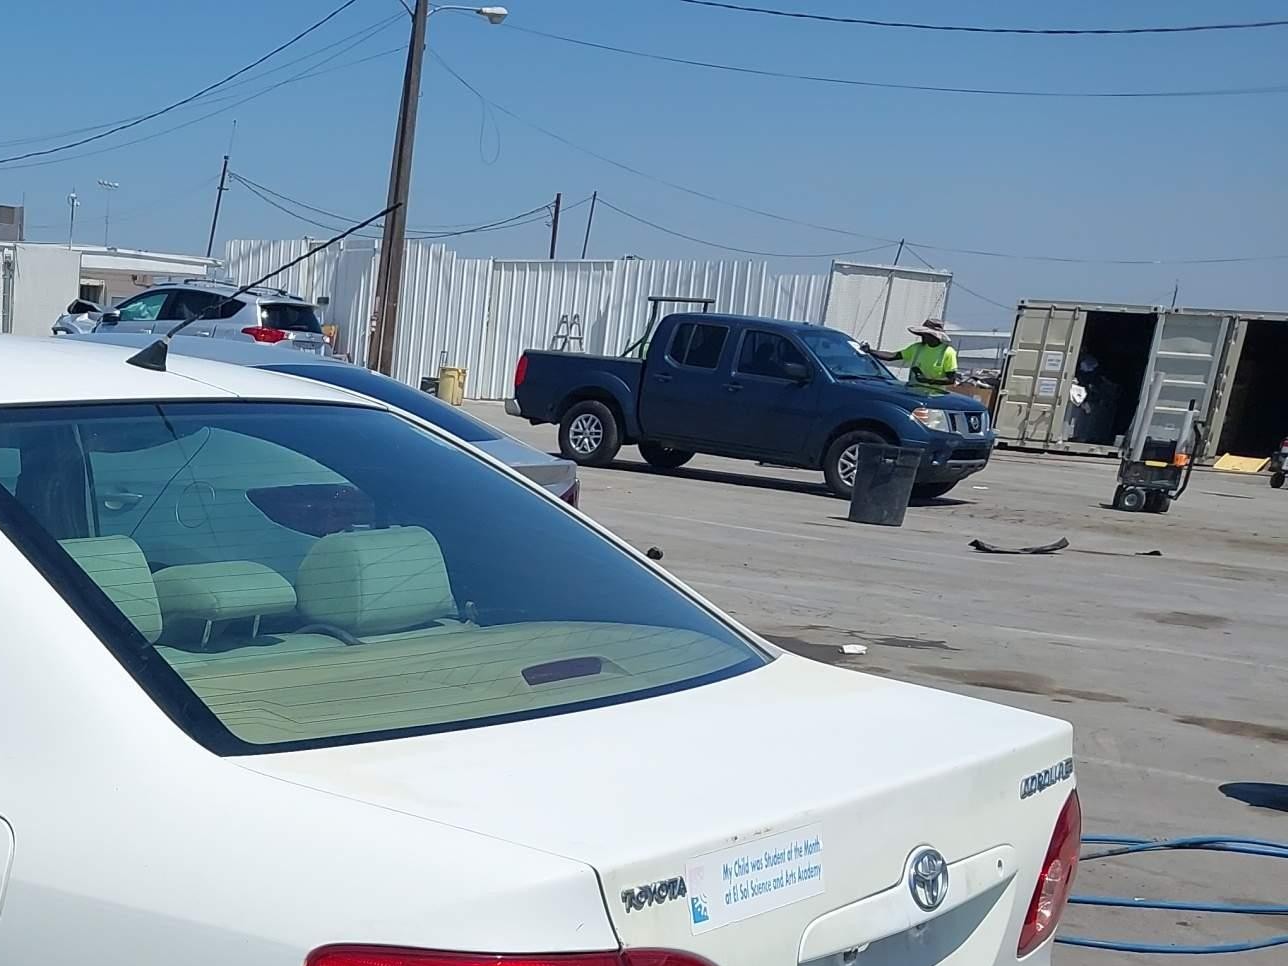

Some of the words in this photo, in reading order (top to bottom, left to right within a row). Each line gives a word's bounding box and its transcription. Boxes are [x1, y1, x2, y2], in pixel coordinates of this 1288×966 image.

[722, 863, 733, 885] My
[734, 856, 749, 878] Child
[751, 860, 764, 873] was
[764, 848, 787, 871] Student
[787, 842, 794, 861] of
[794, 841, 803, 859] the
[725, 892, 732, 905] at
[732, 886, 739, 903] El
[739, 881, 750, 901] Sol
[751, 879, 772, 898] Science
[772, 875, 784, 890] and
[785, 869, 797, 887] Arts
[797, 863, 822, 883] Academy
[621, 876, 687, 913] TOYOTA
